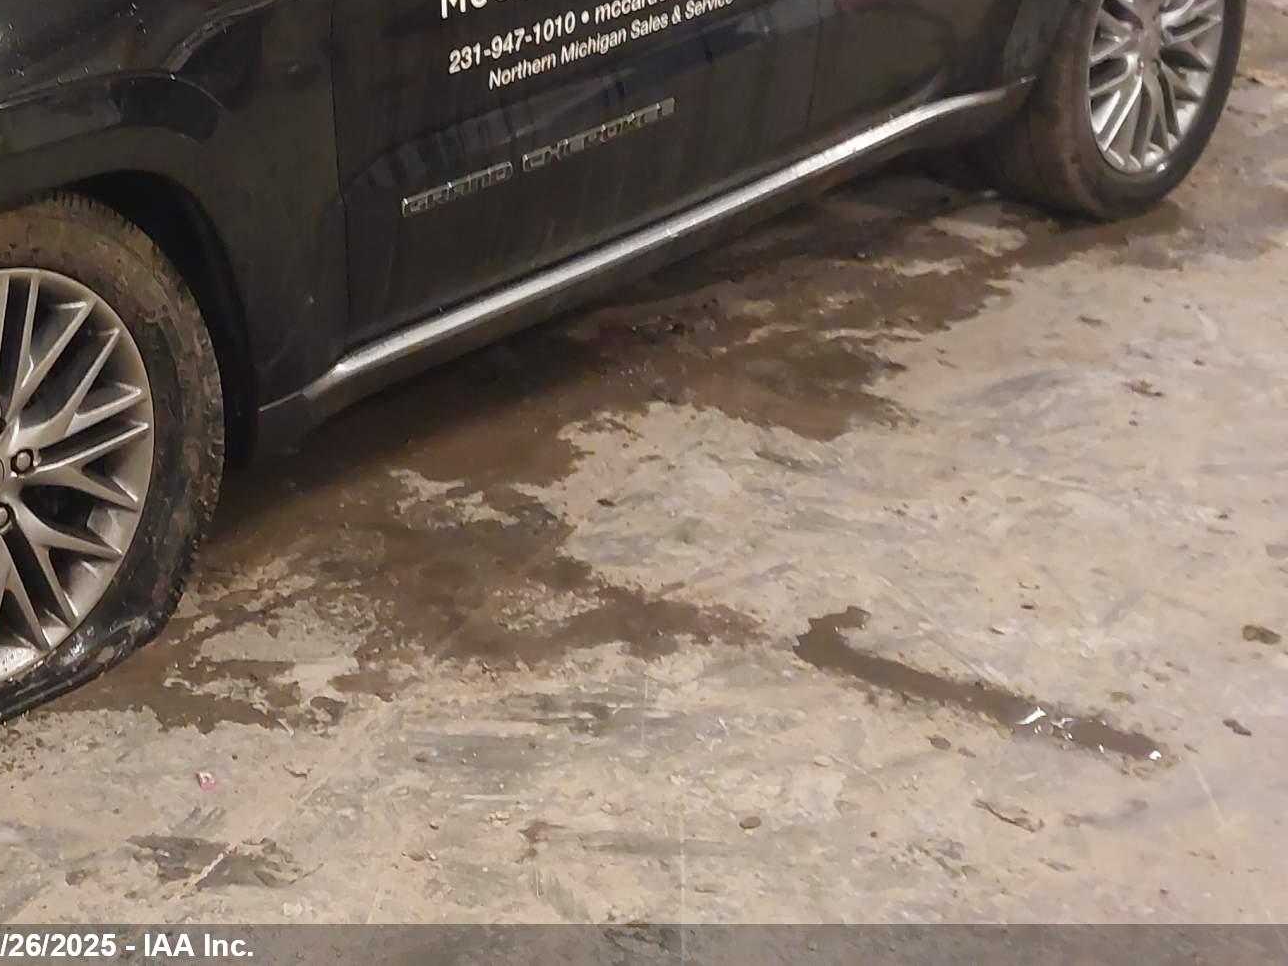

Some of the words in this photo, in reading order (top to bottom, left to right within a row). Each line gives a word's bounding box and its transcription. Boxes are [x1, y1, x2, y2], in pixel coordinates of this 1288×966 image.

[448, 10, 576, 75] 231-947-1010
[488, 54, 557, 90] Northern
[560, 32, 627, 66] Michigan
[630, 16, 669, 40] Sales
[671, 8, 682, 25] &
